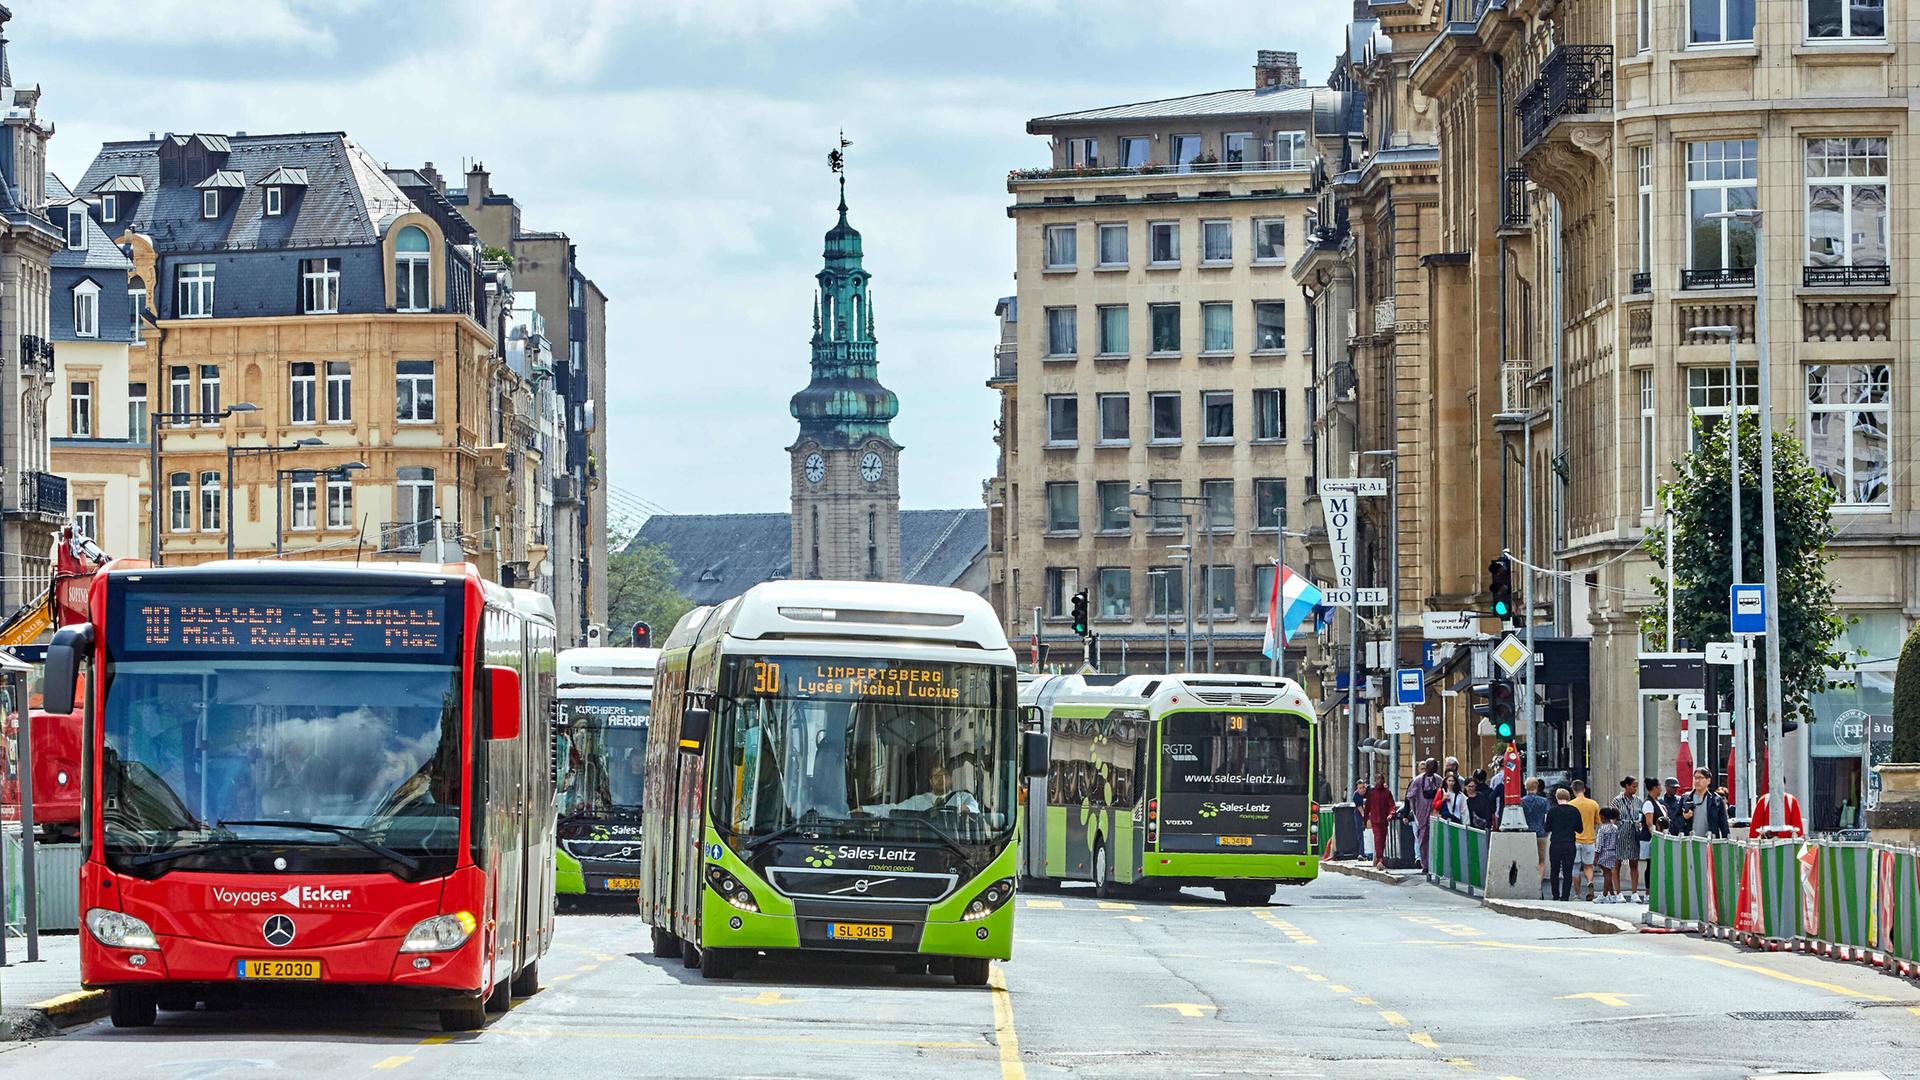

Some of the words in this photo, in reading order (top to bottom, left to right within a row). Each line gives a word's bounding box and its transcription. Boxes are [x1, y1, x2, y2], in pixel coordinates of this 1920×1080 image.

[1323, 482, 1384, 492] CRAL
[1329, 498, 1352, 587] MOLITOR
[1326, 591, 1384, 602] HOTEL
[142, 607, 169, 644] 10
[312, 609, 440, 625] STEINSEL
[251, 628, 354, 646] Rodange
[1720, 650, 1728, 660] 4
[754, 662, 780, 693] 30
[817, 666, 943, 682] LIMPERTSBERG
[798, 676, 843, 695] Lycée
[849, 679, 901, 697] Michel
[908, 683, 960, 698] Lucius
[575, 705, 626, 714] KIRCHBERG
[1691, 701, 1697, 710] 4
[1230, 716, 1243, 730] 30
[1394, 721, 1400, 730] 3
[1162, 744, 1193, 755] RGTR
[1184, 773, 1286, 784] www.sales-lentz.lu
[1219, 802, 1271, 812] Sales-Lentz
[838, 846, 917, 861] Sales-Lentz
[868, 863, 892, 872] moving
[893, 865, 914, 873] people
[213, 887, 277, 906] Voyages
[302, 885, 351, 901] Ecker
[839, 926, 853, 936] SL
[856, 926, 886, 937] 3485
[253, 963, 272, 976] VE
[275, 963, 312, 976] 2030
